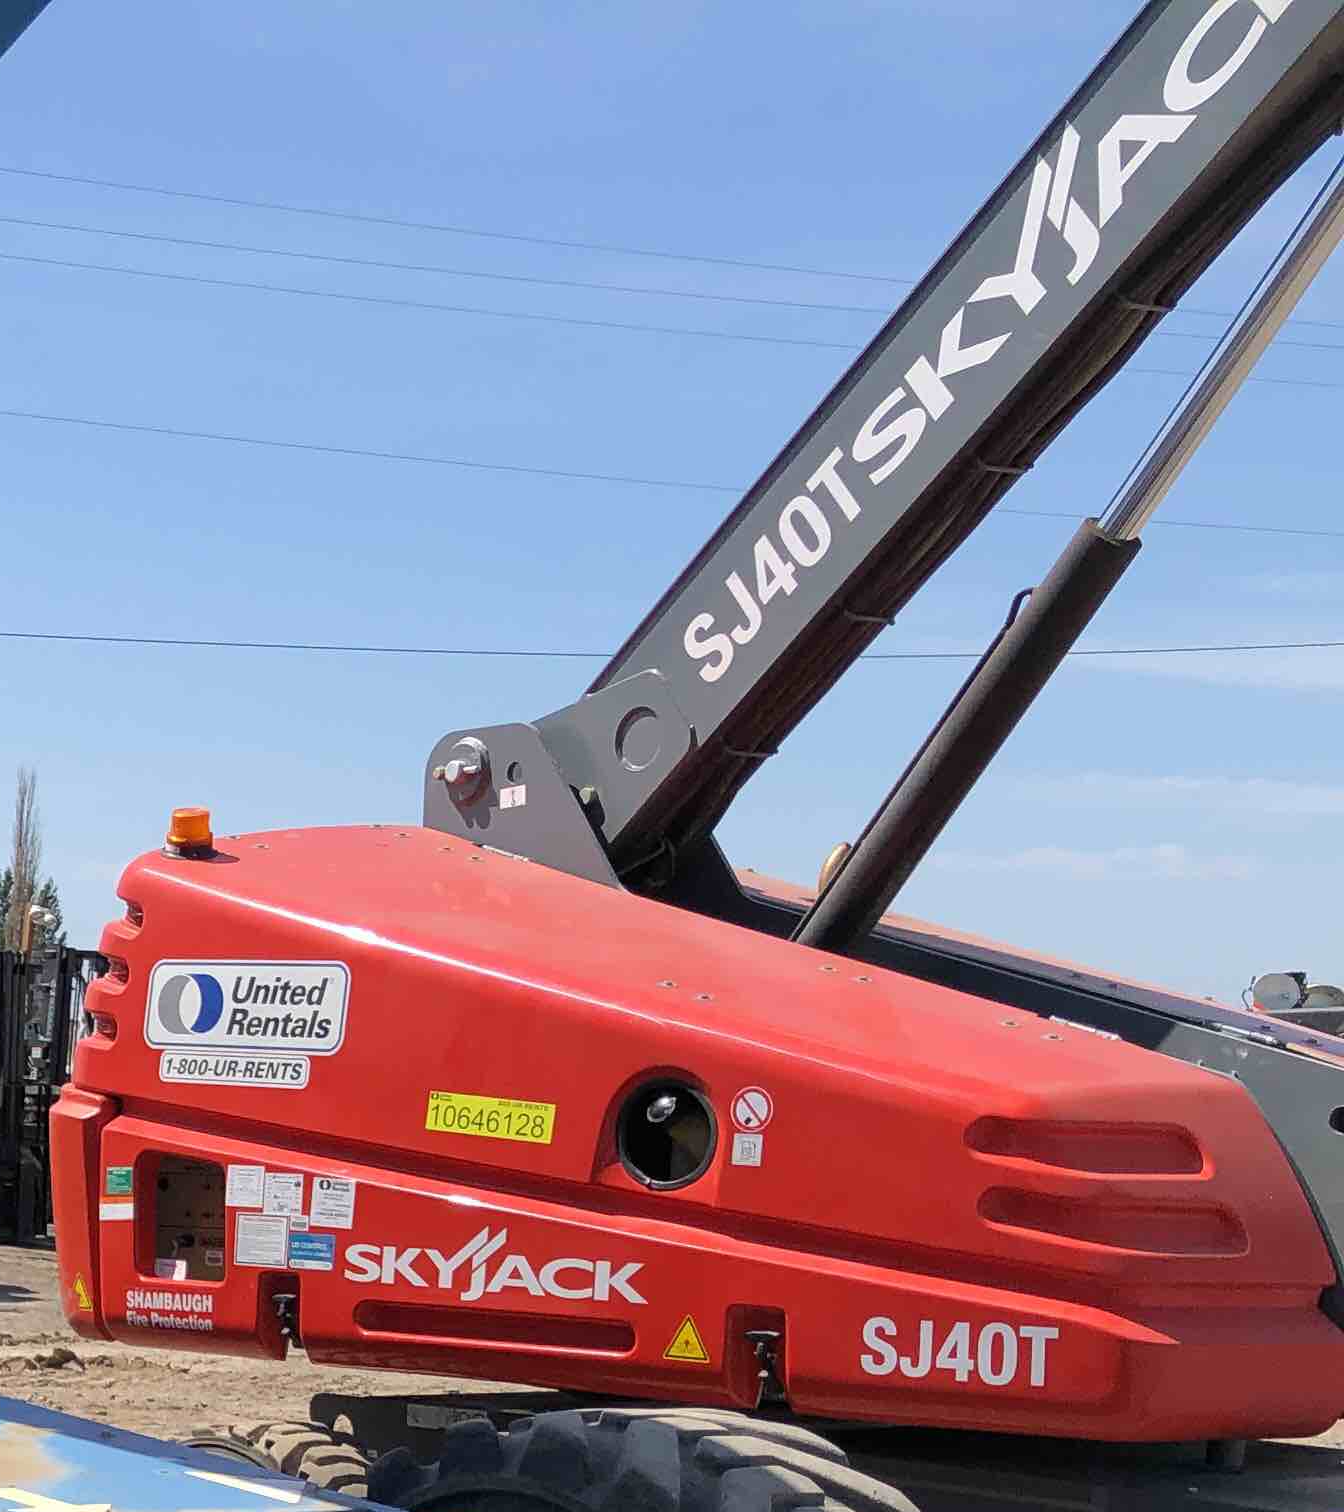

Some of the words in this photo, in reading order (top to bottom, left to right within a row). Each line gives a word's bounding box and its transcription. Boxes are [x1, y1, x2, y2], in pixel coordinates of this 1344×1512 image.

[682, 448, 865, 684] SJ40T
[850, 0, 1293, 486] SKYJAC
[231, 975, 329, 1006] United
[226, 1008, 332, 1039] Rentals
[165, 1057, 303, 1081] 1-800-UR-RENTS
[431, 1103, 545, 1138] 10646128
[344, 1225, 648, 1305] SKYJACK
[126, 1290, 213, 1313] SHAMBAUGH
[126, 1310, 148, 1328] Fire
[150, 1312, 213, 1331] Protection
[859, 1317, 1060, 1387] SJ40T
